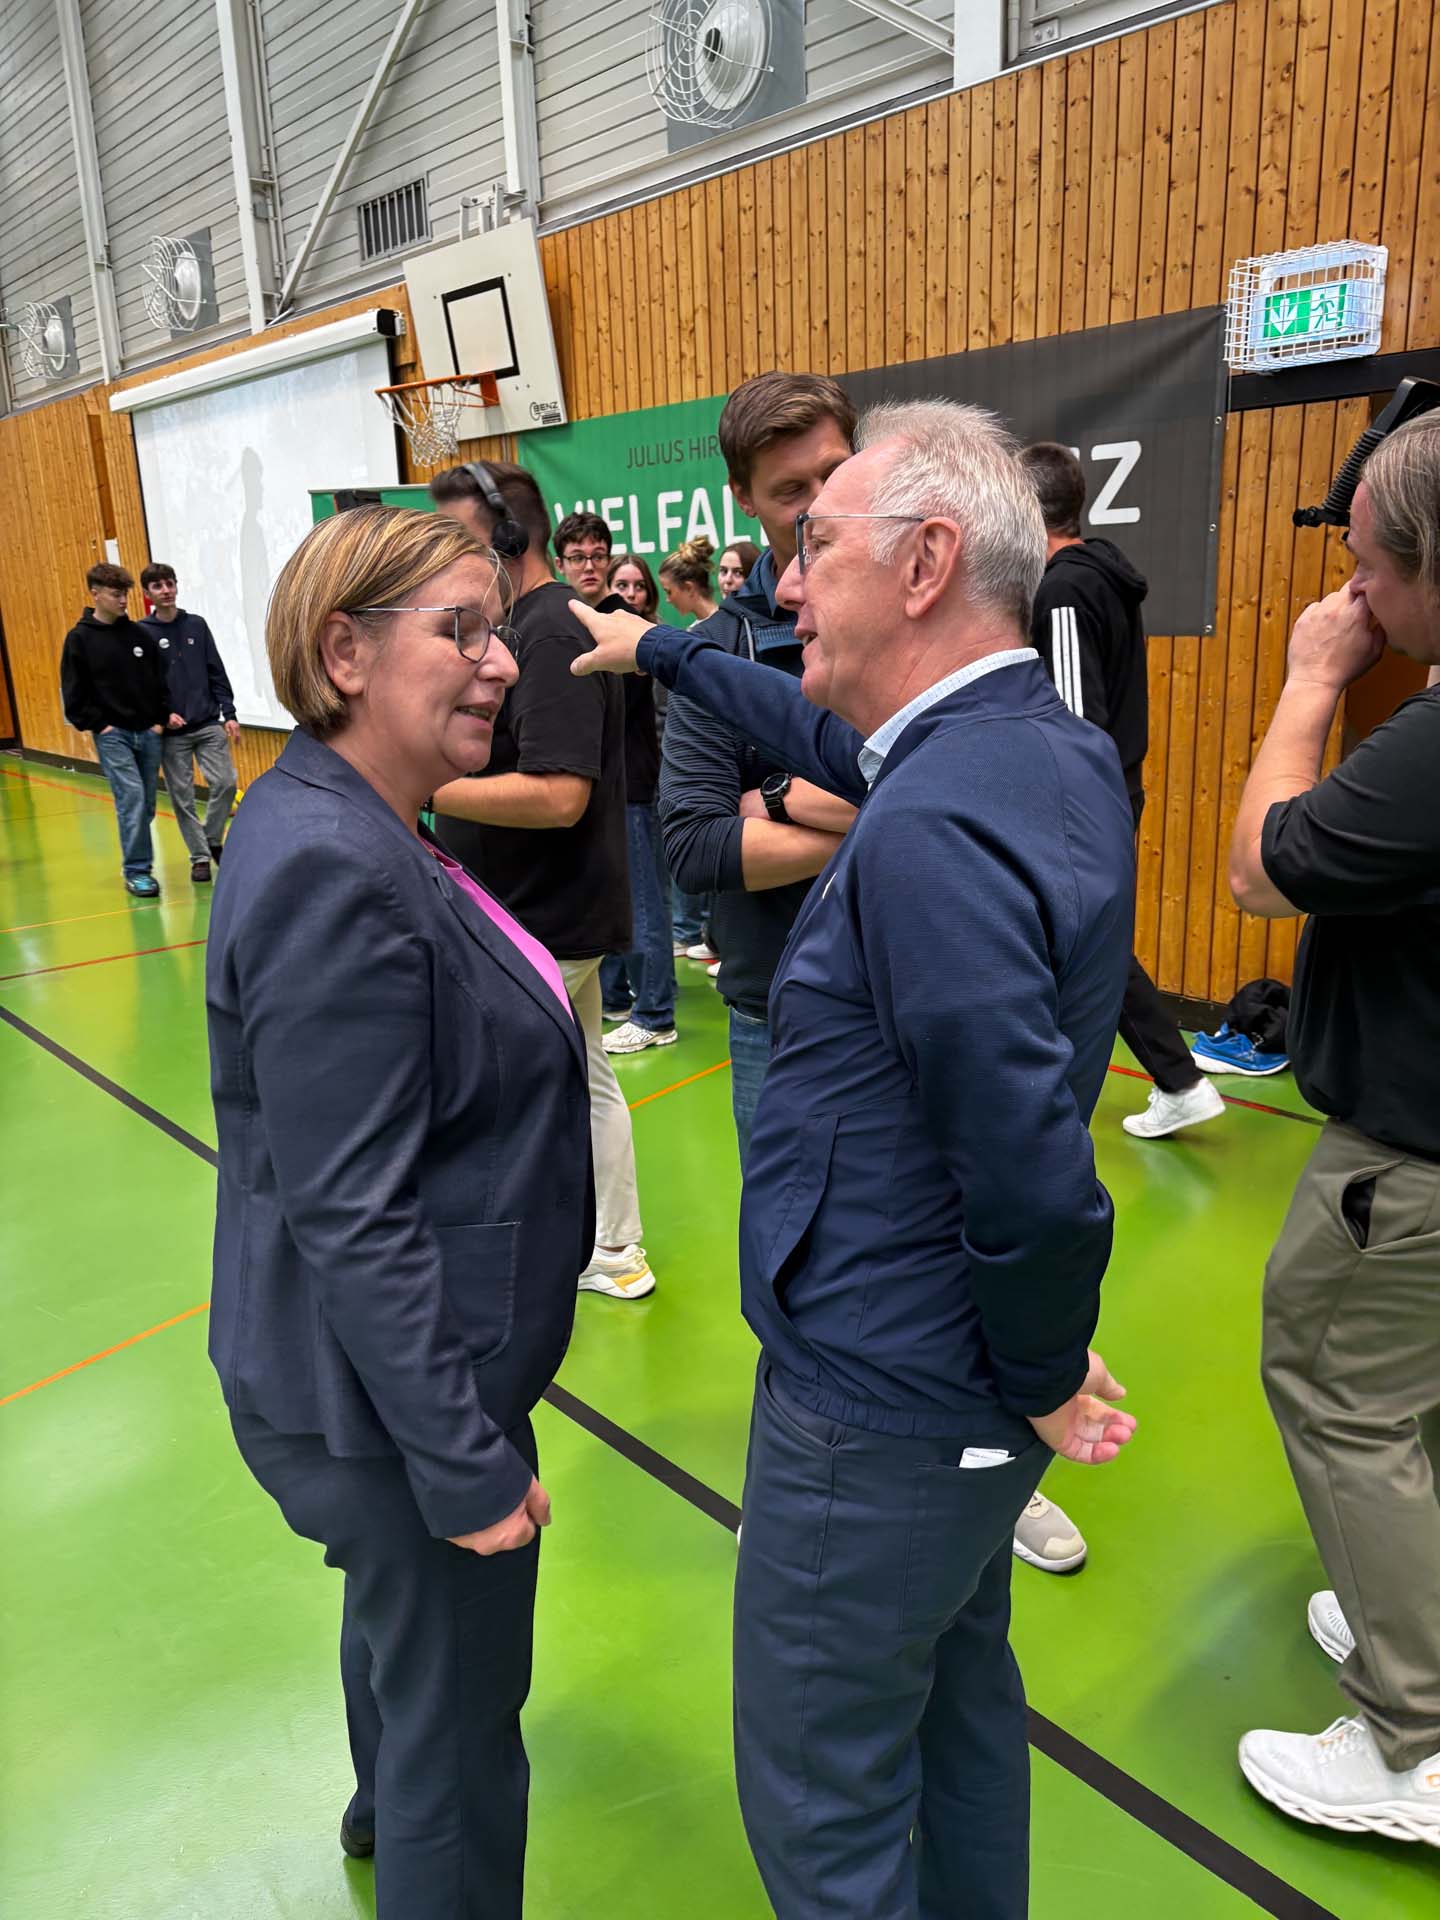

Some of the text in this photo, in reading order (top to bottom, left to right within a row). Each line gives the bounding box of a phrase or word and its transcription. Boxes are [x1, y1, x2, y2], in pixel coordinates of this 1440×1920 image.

[532, 401, 559, 414] BENZ
[627, 439, 684, 469] JULIUS
[554, 486, 769, 554] ELFAL
